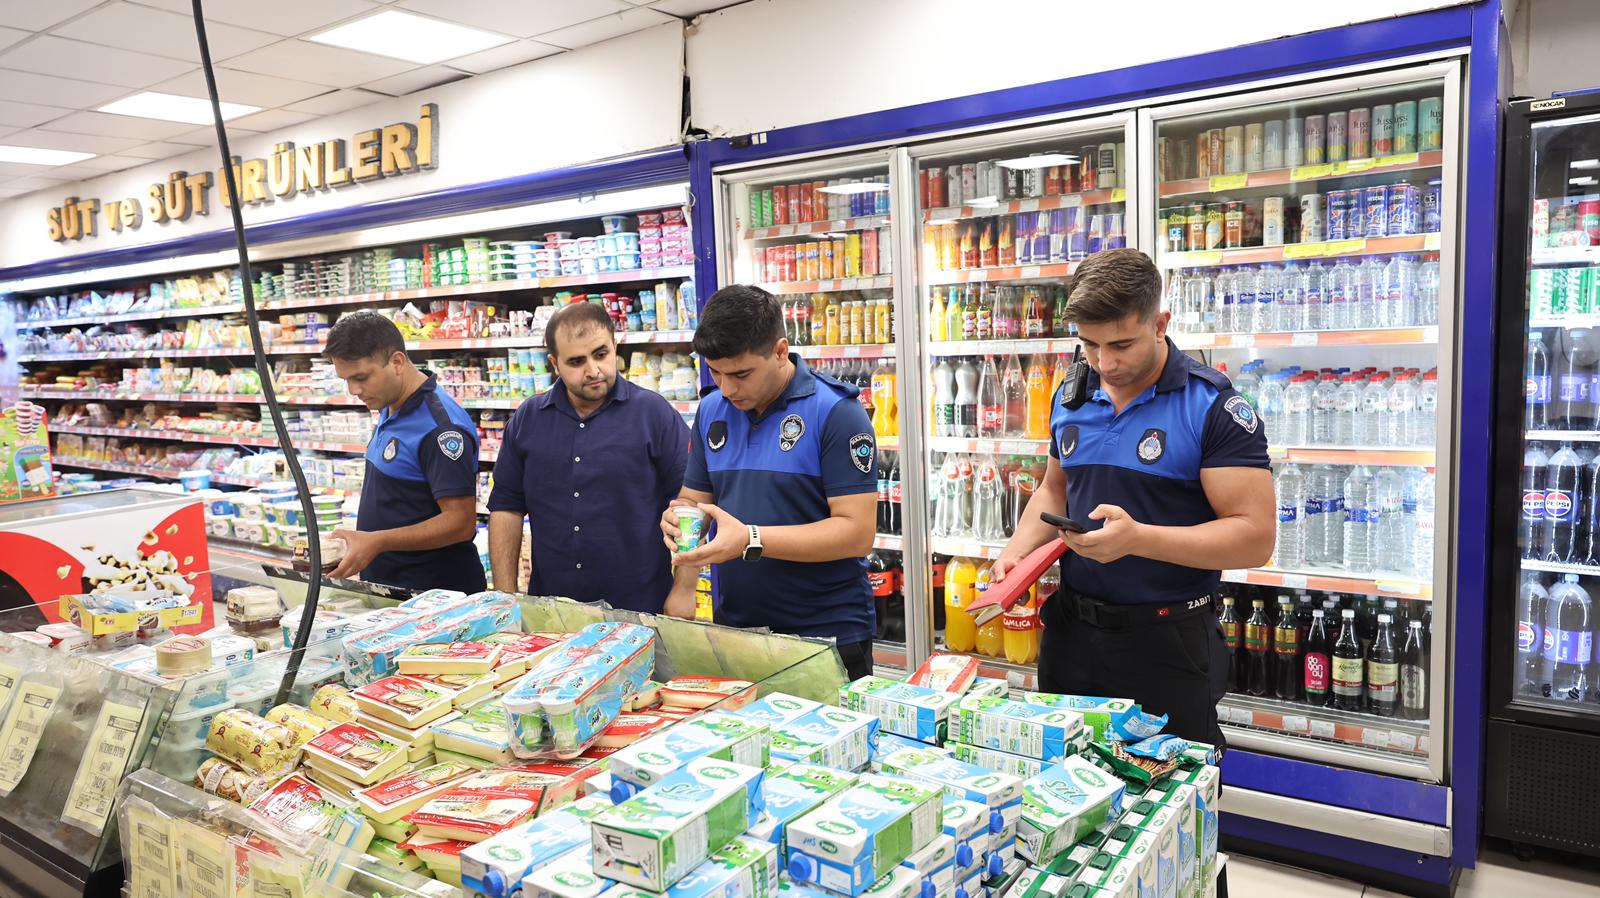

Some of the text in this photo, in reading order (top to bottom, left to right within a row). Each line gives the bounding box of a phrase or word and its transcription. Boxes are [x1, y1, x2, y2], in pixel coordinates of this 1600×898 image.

[47, 196, 99, 242] SÜT
[104, 198, 142, 230] ve
[148, 171, 213, 223] SÜT
[1187, 594, 1211, 609] ZABIT
